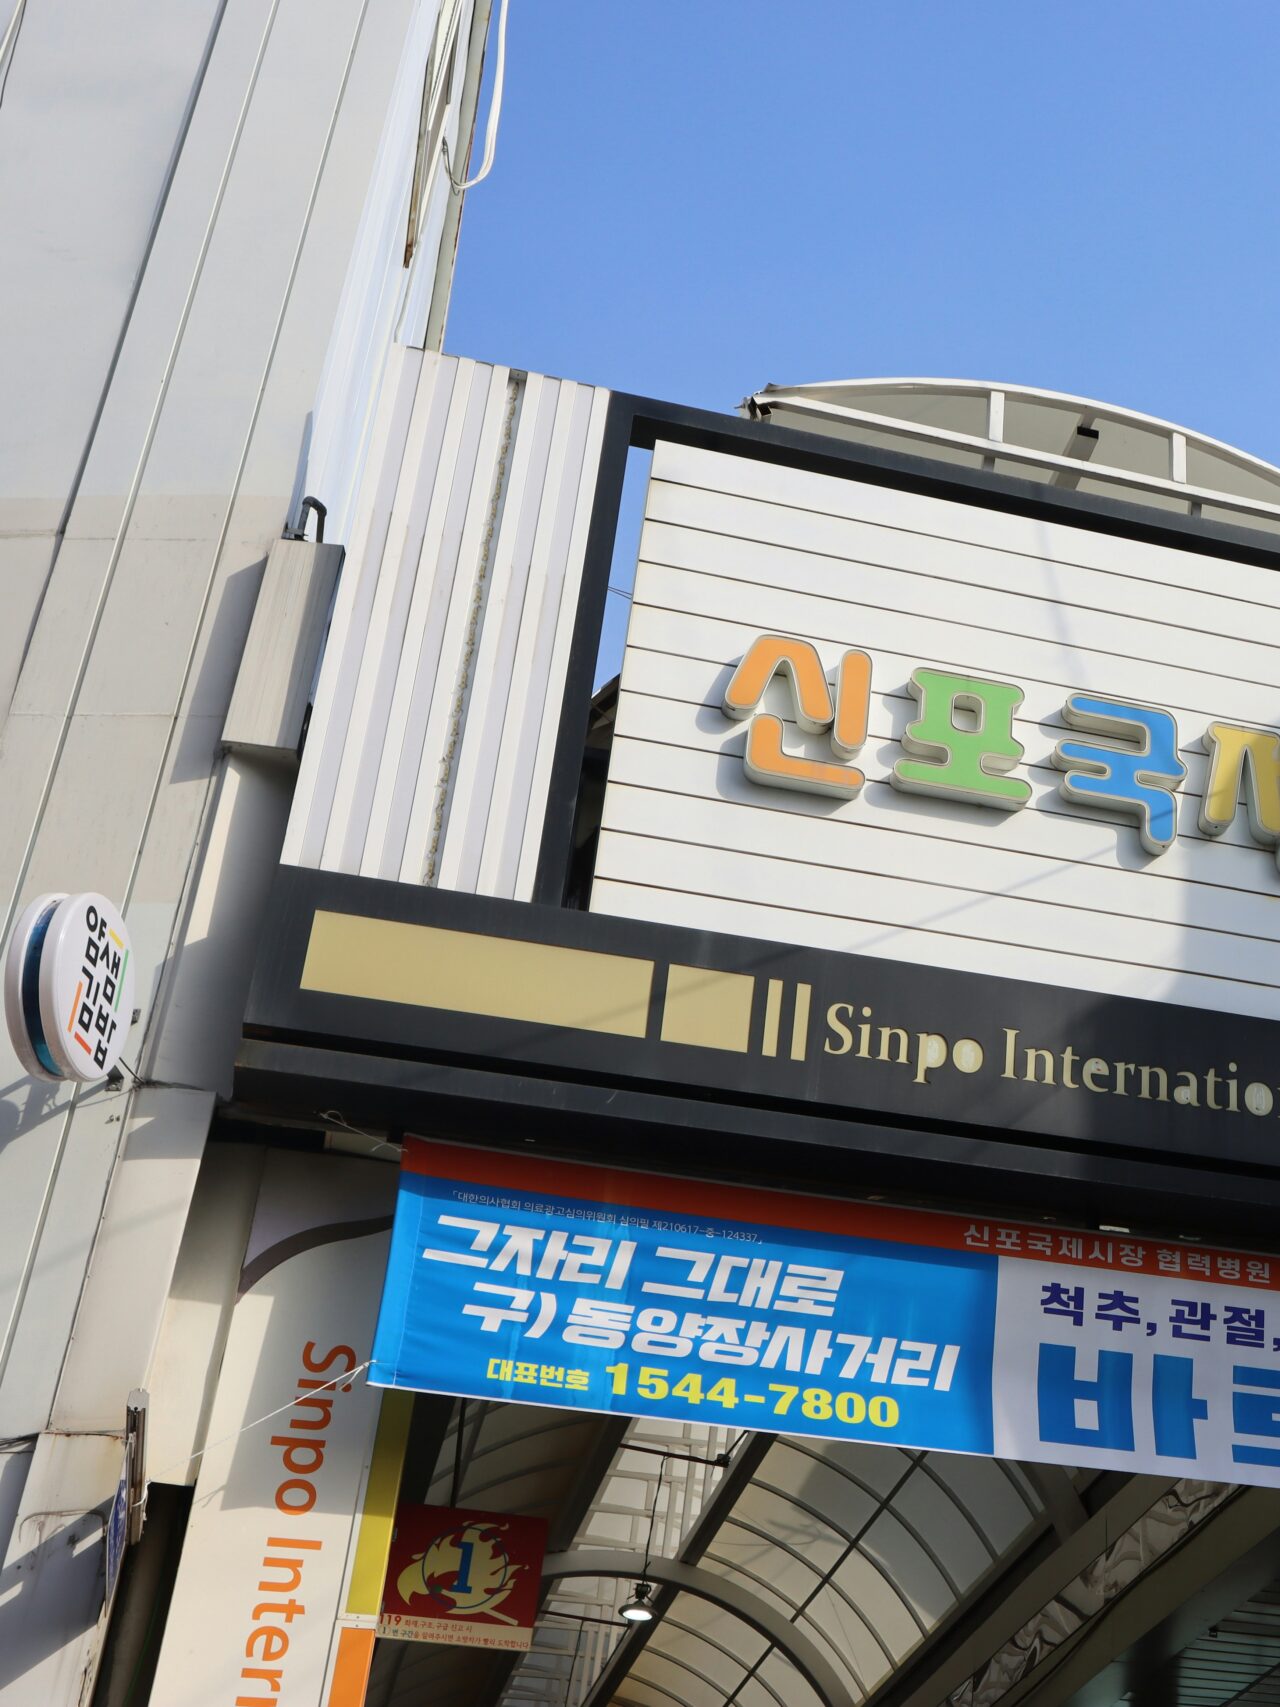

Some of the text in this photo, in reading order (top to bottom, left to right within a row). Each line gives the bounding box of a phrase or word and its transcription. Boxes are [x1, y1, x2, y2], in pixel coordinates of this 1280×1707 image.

[824, 1002, 984, 1084] Sinpo
[524, 1201, 616, 1224] 의료광고심의위원회
[620, 1215, 649, 1230] 심의필
[423, 1214, 845, 1318] 그자리 그대로
[963, 1224, 1271, 1284] 신포국제시장 협력병원
[271, 1341, 356, 1515] Sinpo
[486, 1358, 900, 1428] 대표번호 1544-7800
[379, 1614, 402, 1626] 119
